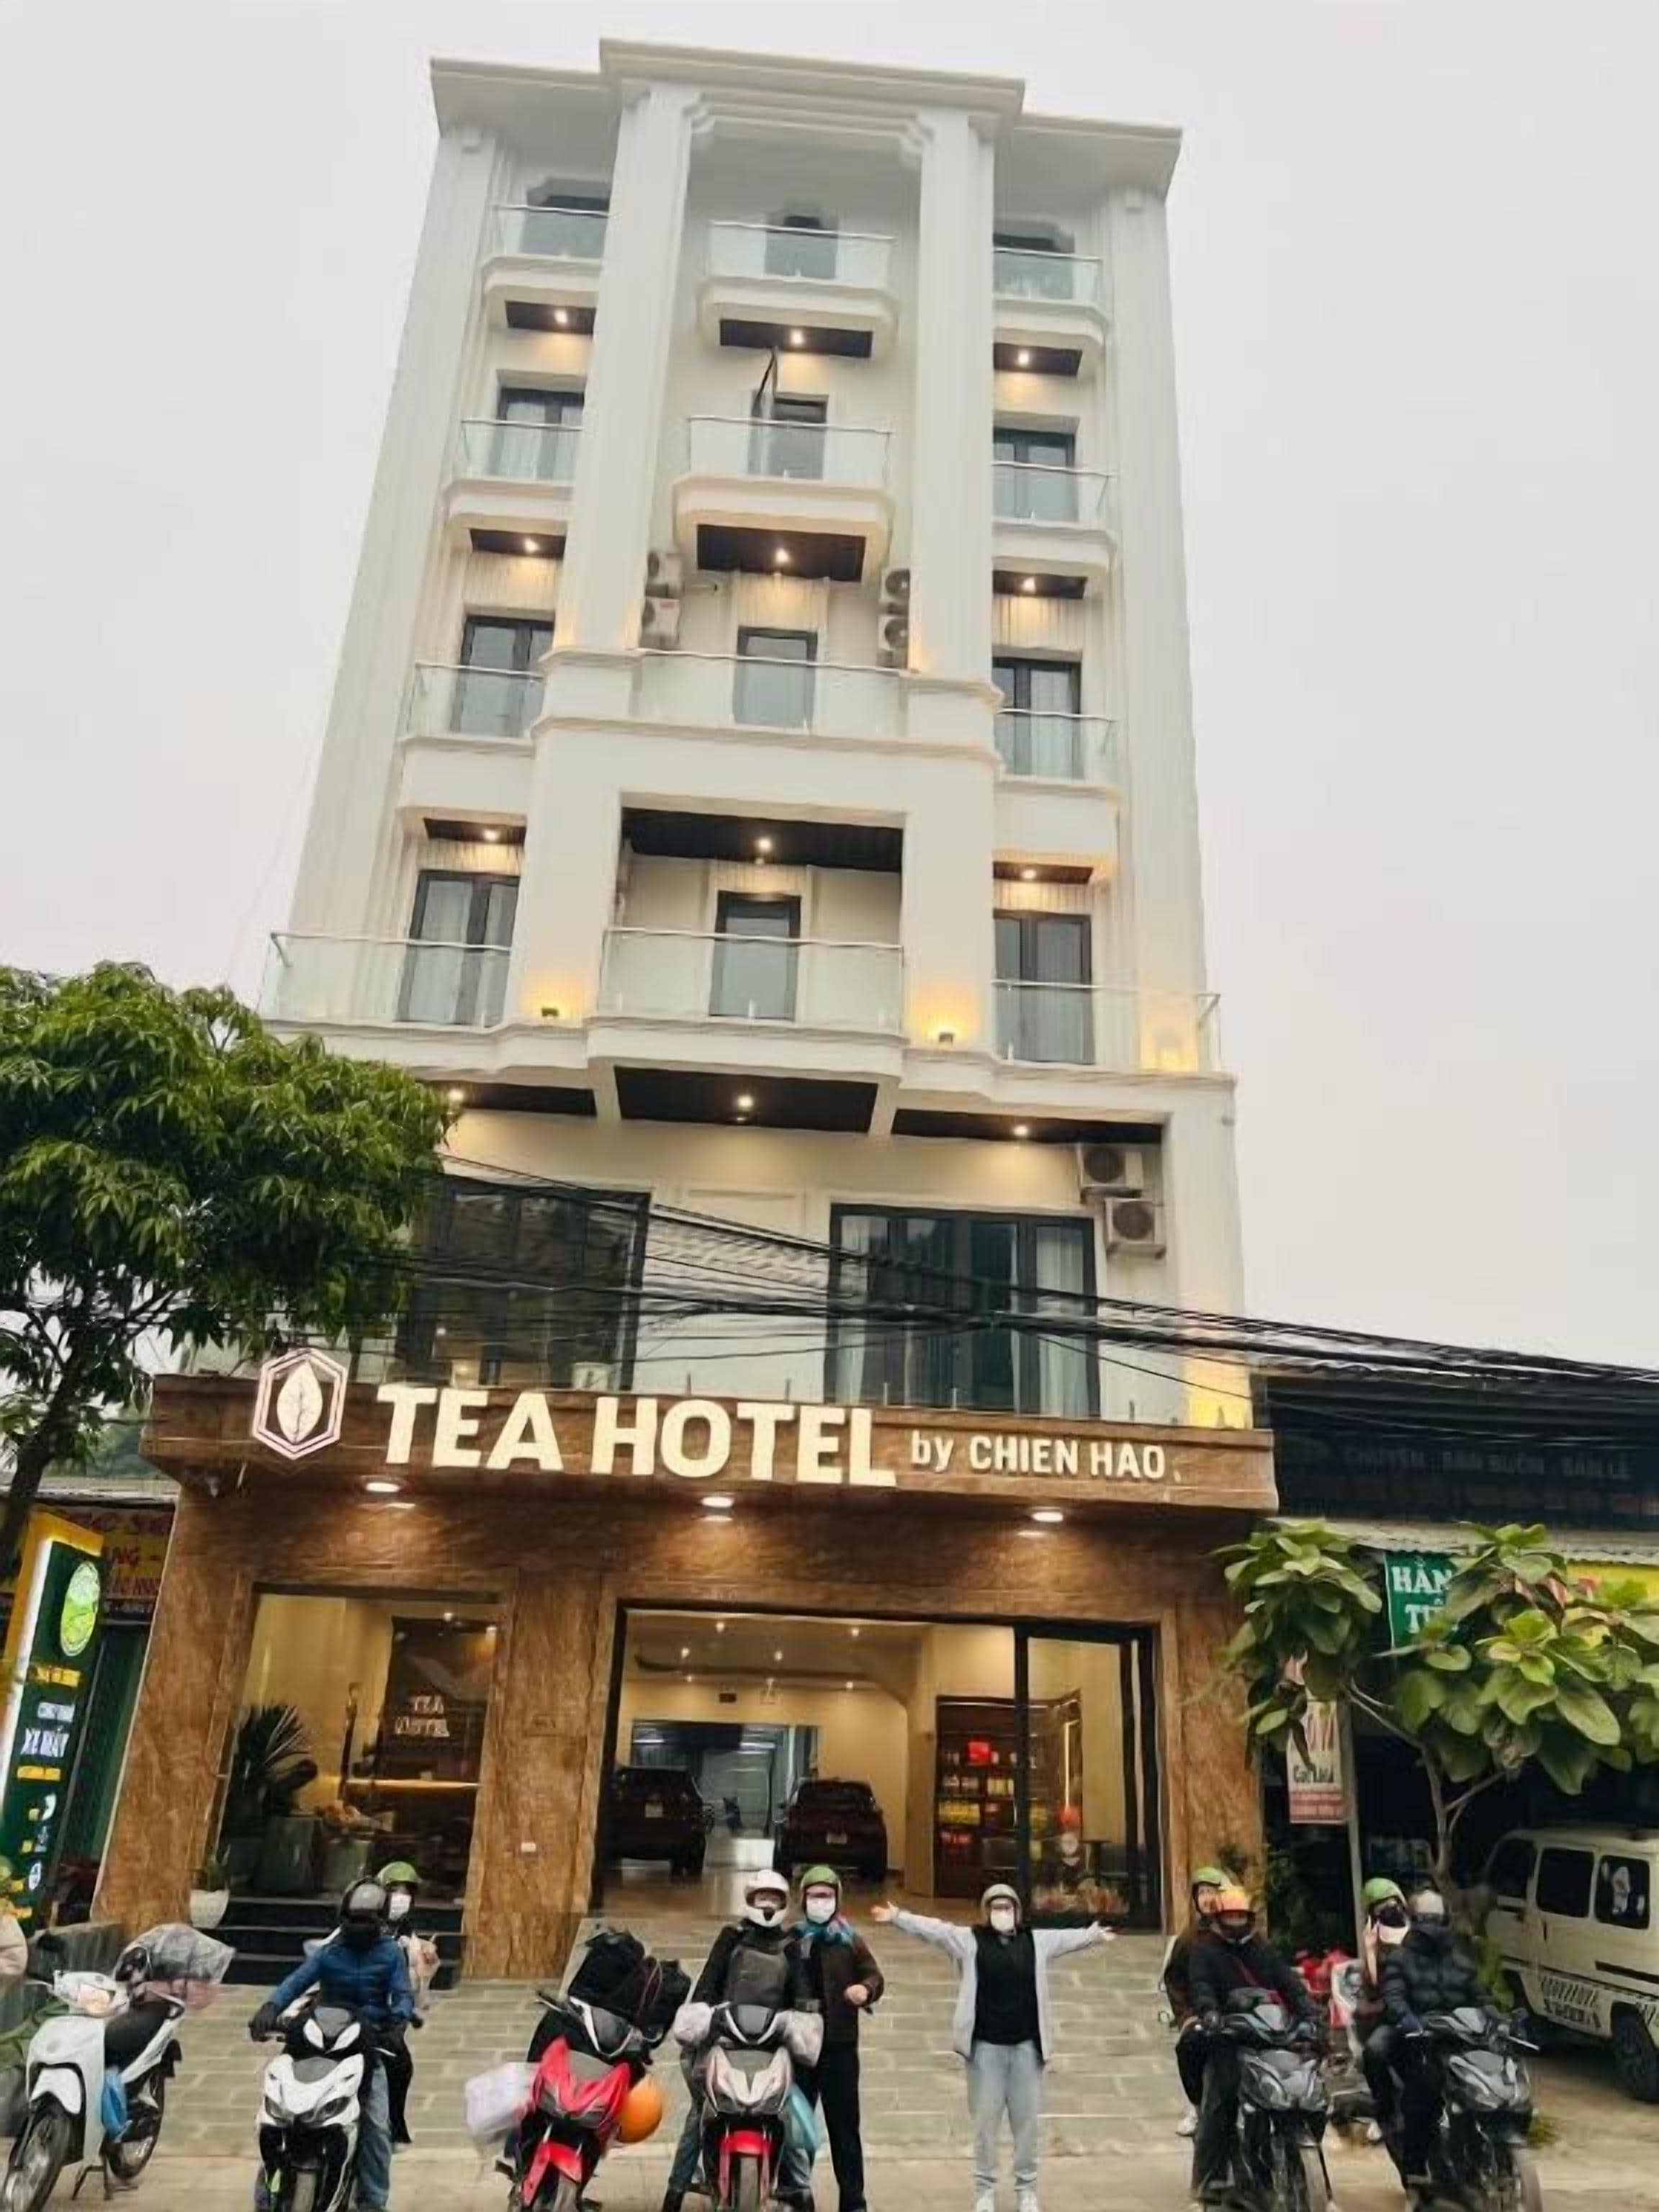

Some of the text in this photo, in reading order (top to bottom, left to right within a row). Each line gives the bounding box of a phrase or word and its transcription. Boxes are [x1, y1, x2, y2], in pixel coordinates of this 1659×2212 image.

[377, 1383, 1166, 1487] TEA HOTEL by CHIEN HAO
